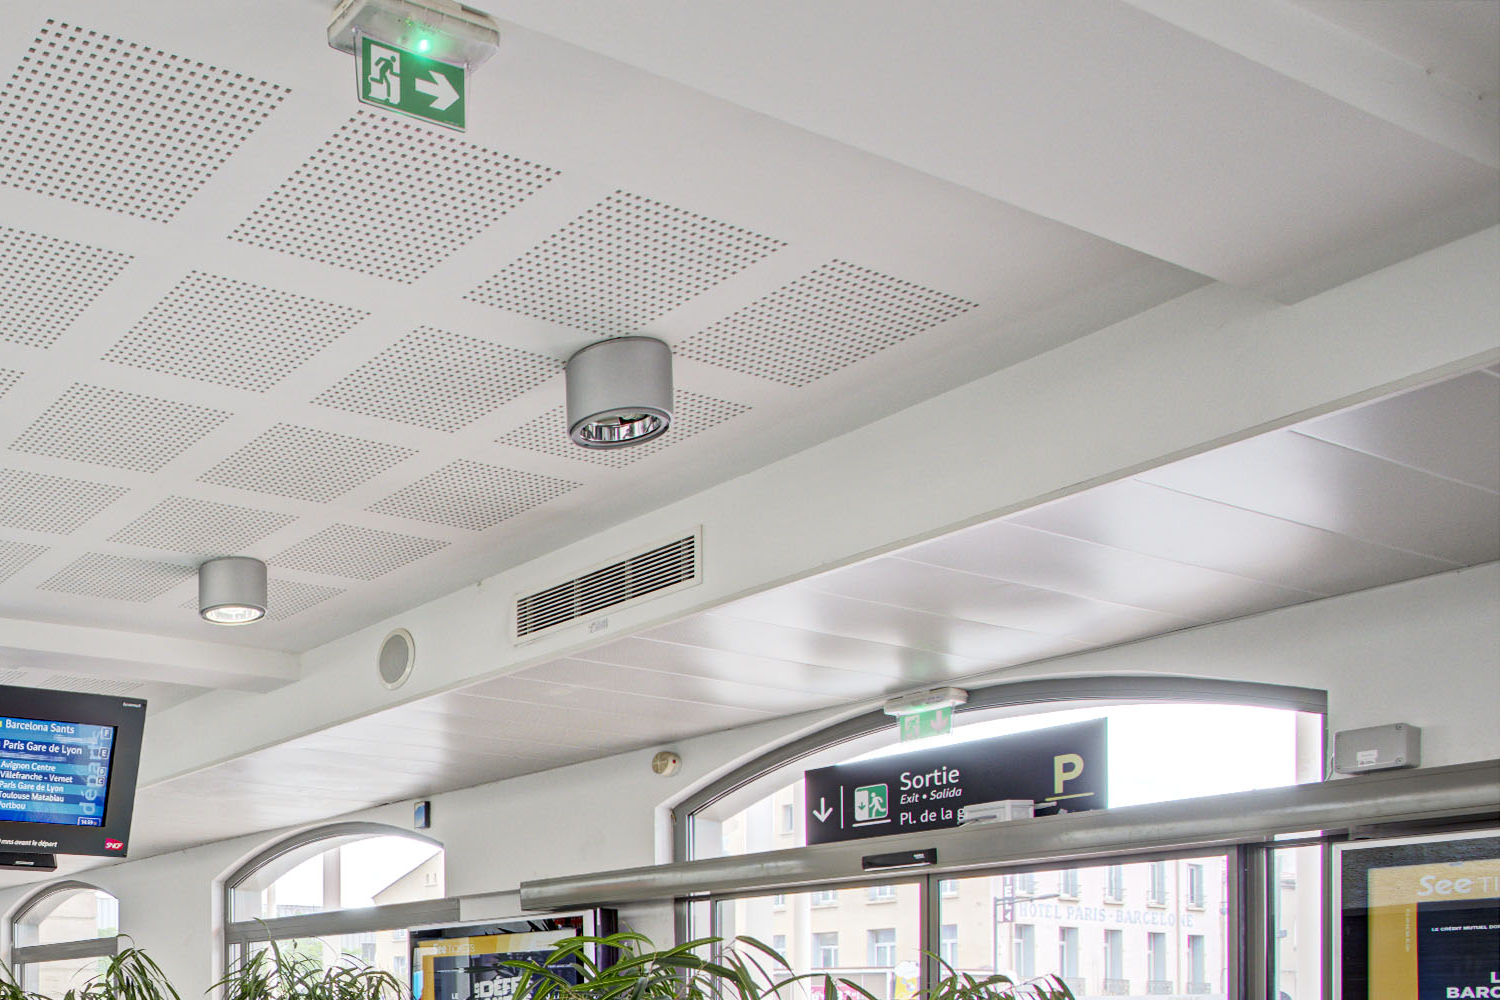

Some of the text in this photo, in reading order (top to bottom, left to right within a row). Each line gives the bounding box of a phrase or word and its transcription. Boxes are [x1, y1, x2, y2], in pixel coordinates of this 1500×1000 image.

[5, 719, 48, 732] Barcelona
[50, 723, 75, 734] Sants
[3, 739, 25, 751] Paris
[26, 742, 47, 752] Gare
[48, 743, 60, 753] de
[61, 745, 83, 757] Lyon
[0, 760, 30, 771] Avignon
[31, 762, 56, 772] Centre
[1053, 753, 1084, 794] P
[0, 770, 43, 781] Villefranche
[49, 774, 73, 783] Vernet
[900, 765, 961, 792] Sortie
[0, 780, 17, 789] Paris
[17, 781, 35, 790] Gare
[36, 783, 46, 791] de
[46, 784, 64, 793] Lyon
[31, 792, 65, 803] Matabiau
[900, 786, 963, 805] Exit Salida
[900, 811, 917, 826] Pl.
[920, 809, 937, 824] de
[941, 808, 953, 821] la
[32, 839, 37, 847] le
[38, 840, 58, 848] départ
[105, 841, 123, 850] SNCF
[1417, 875, 1475, 896] See
[1067, 906, 1106, 922] PARIS
